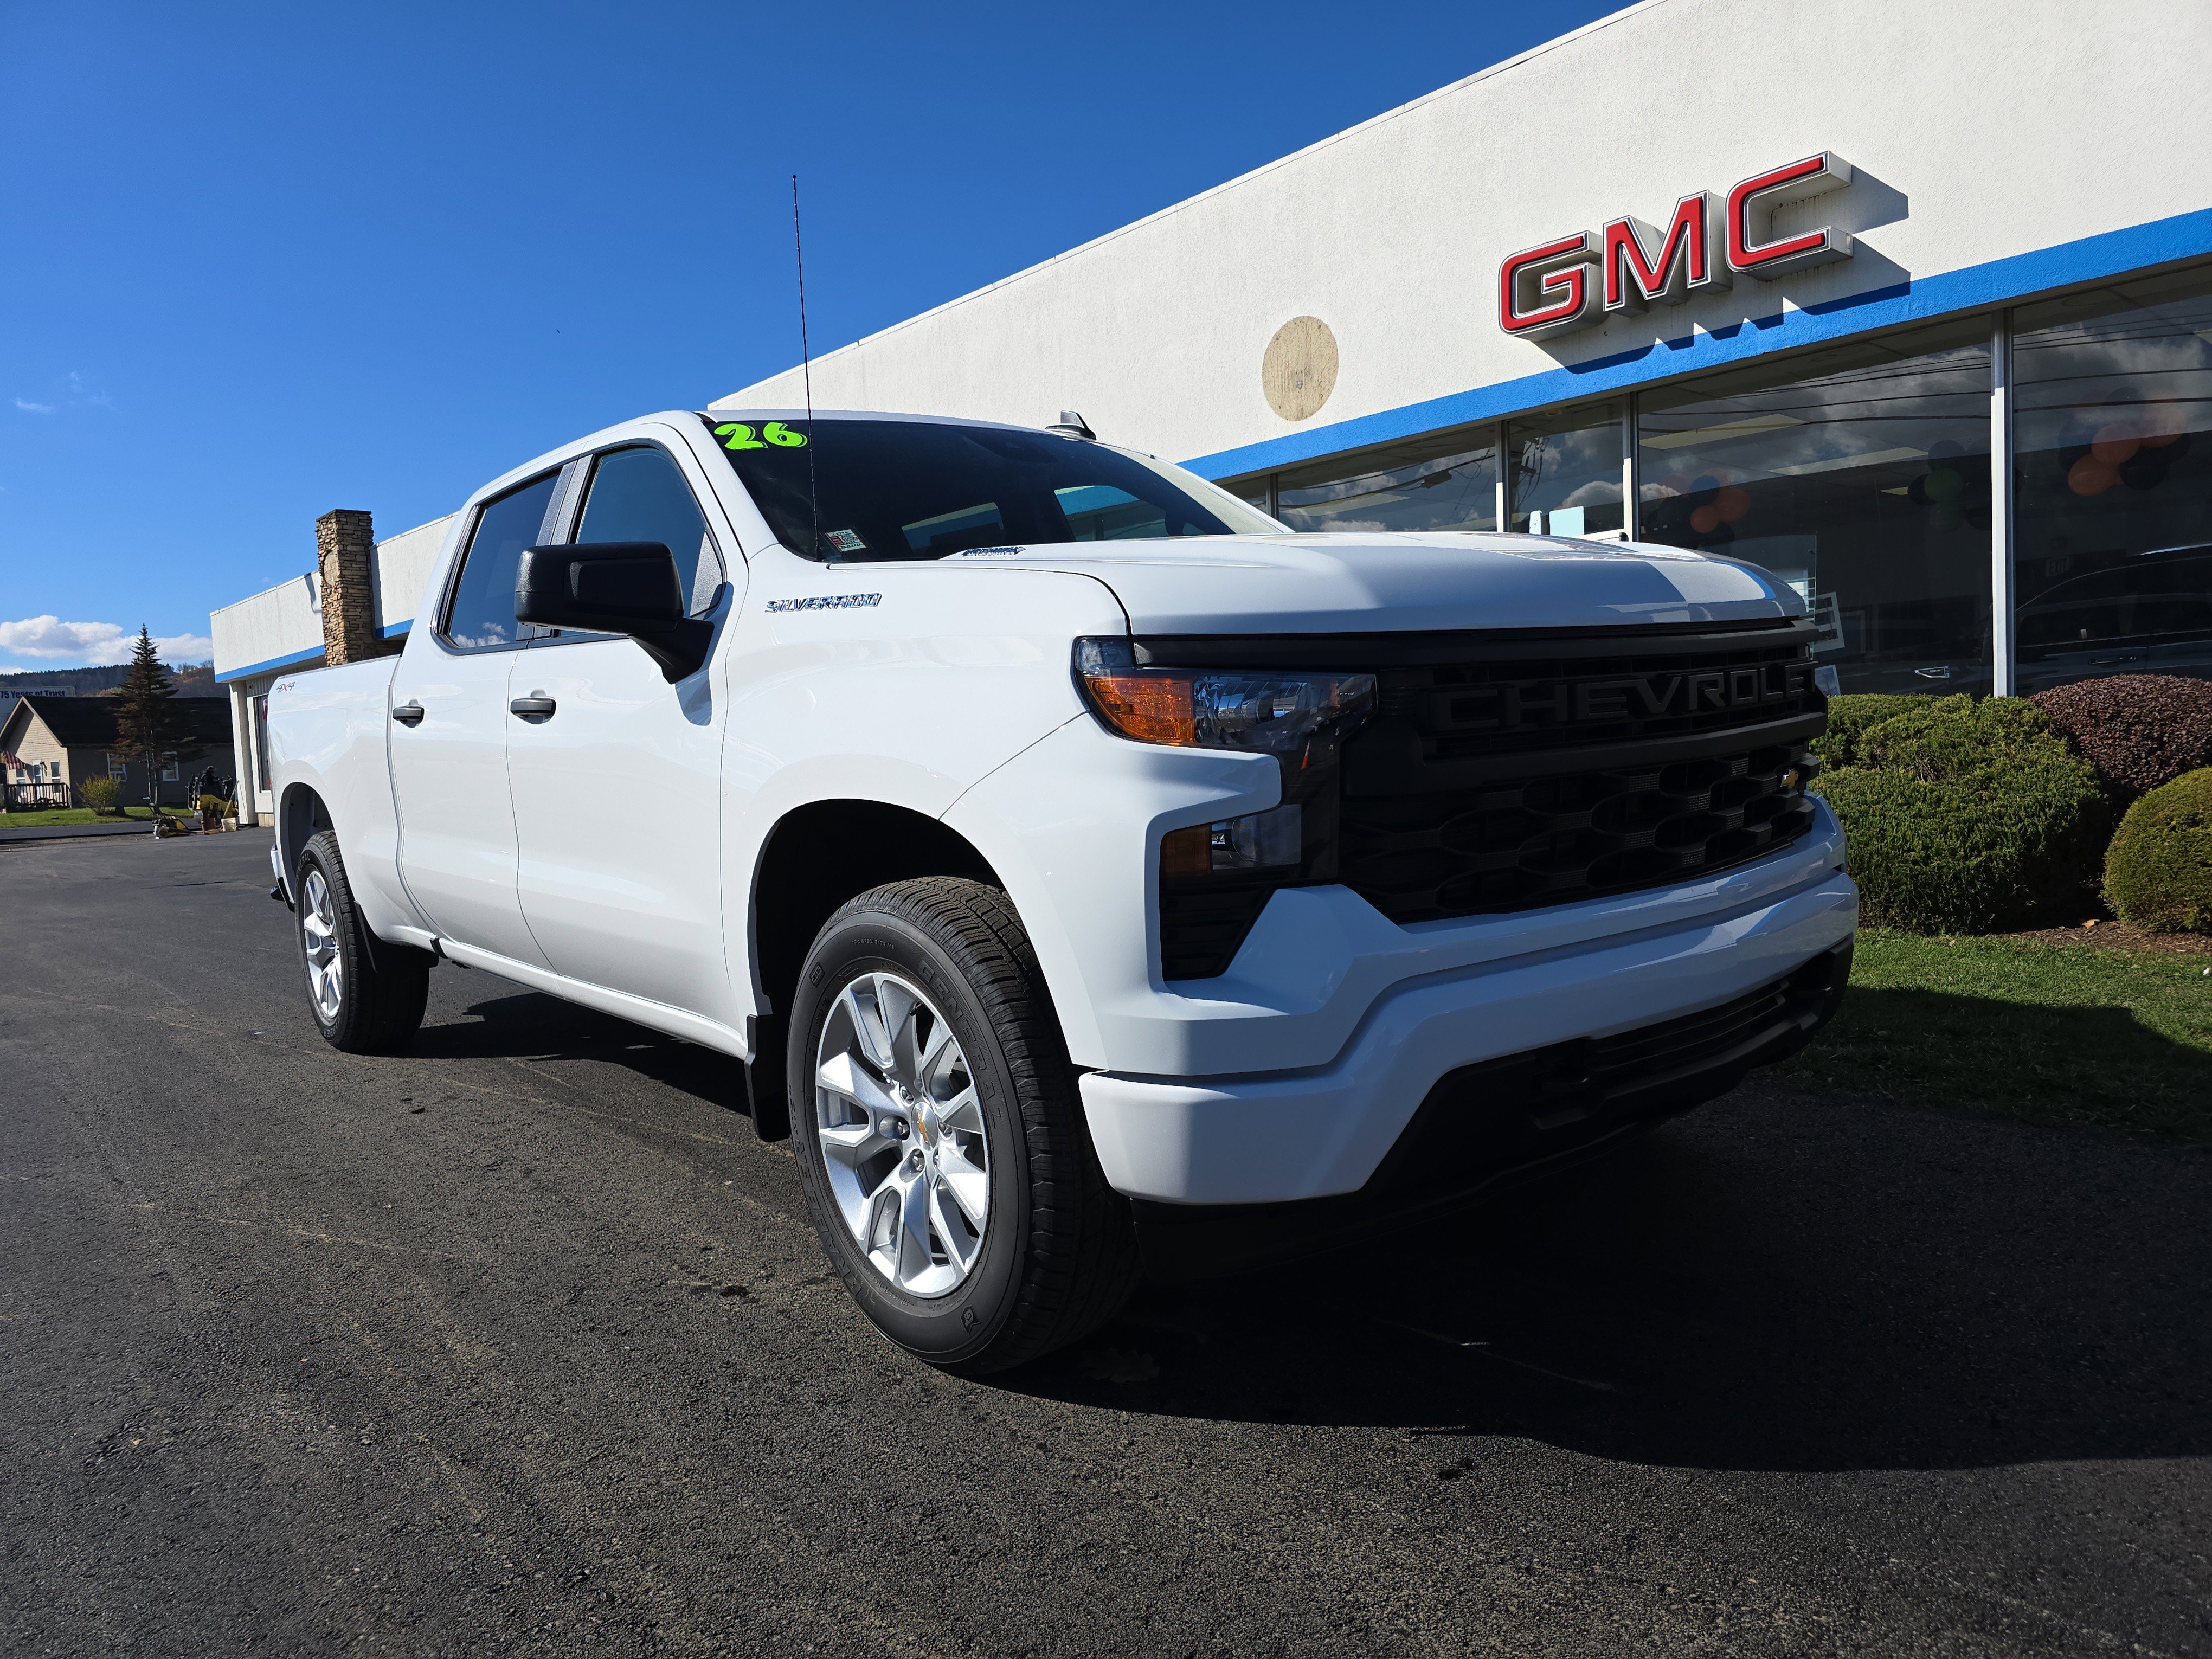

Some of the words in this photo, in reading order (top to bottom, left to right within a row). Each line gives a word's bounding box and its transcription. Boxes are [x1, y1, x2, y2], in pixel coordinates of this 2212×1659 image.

[1498, 150, 1849, 339] GMC
[713, 422, 808, 451] 26
[764, 592, 883, 614] SILVERADO
[11, 690, 34, 699] Years
[918, 959, 1003, 1130] GENERAL
[795, 1137, 864, 1299] GRABBER
